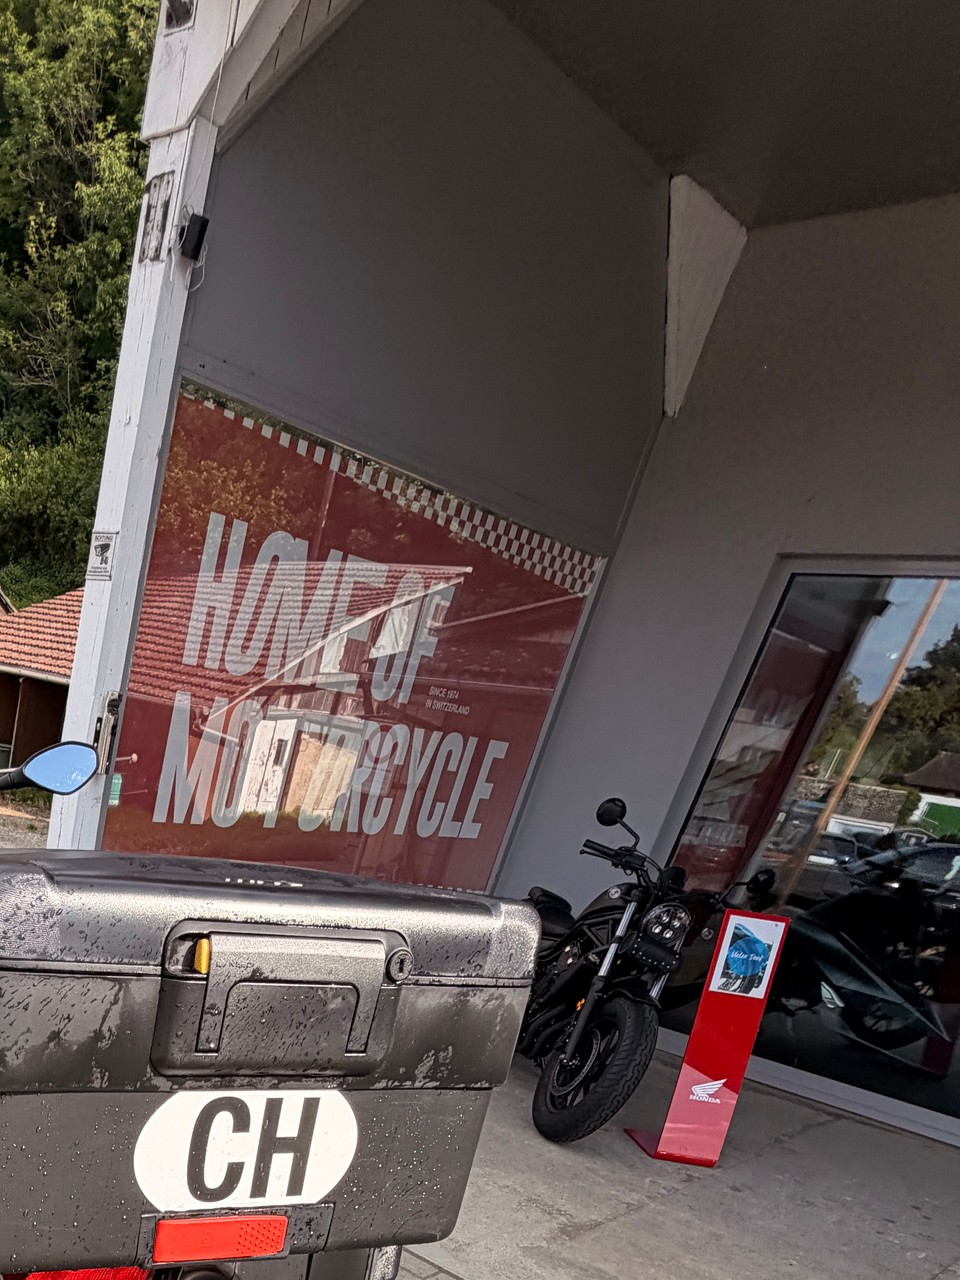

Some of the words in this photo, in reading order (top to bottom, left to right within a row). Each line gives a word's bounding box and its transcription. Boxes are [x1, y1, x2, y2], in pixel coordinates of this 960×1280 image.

[181, 511, 390, 695] HOME
[370, 572, 456, 705] OF
[425, 699, 433, 708] IN
[431, 700, 470, 715] SWITZERLAND
[429, 685, 447, 698] SINCE
[151, 691, 510, 839] MOTORCYCLE
[689, 1094, 721, 1104] HONDA
[186, 1096, 322, 1203] CH
